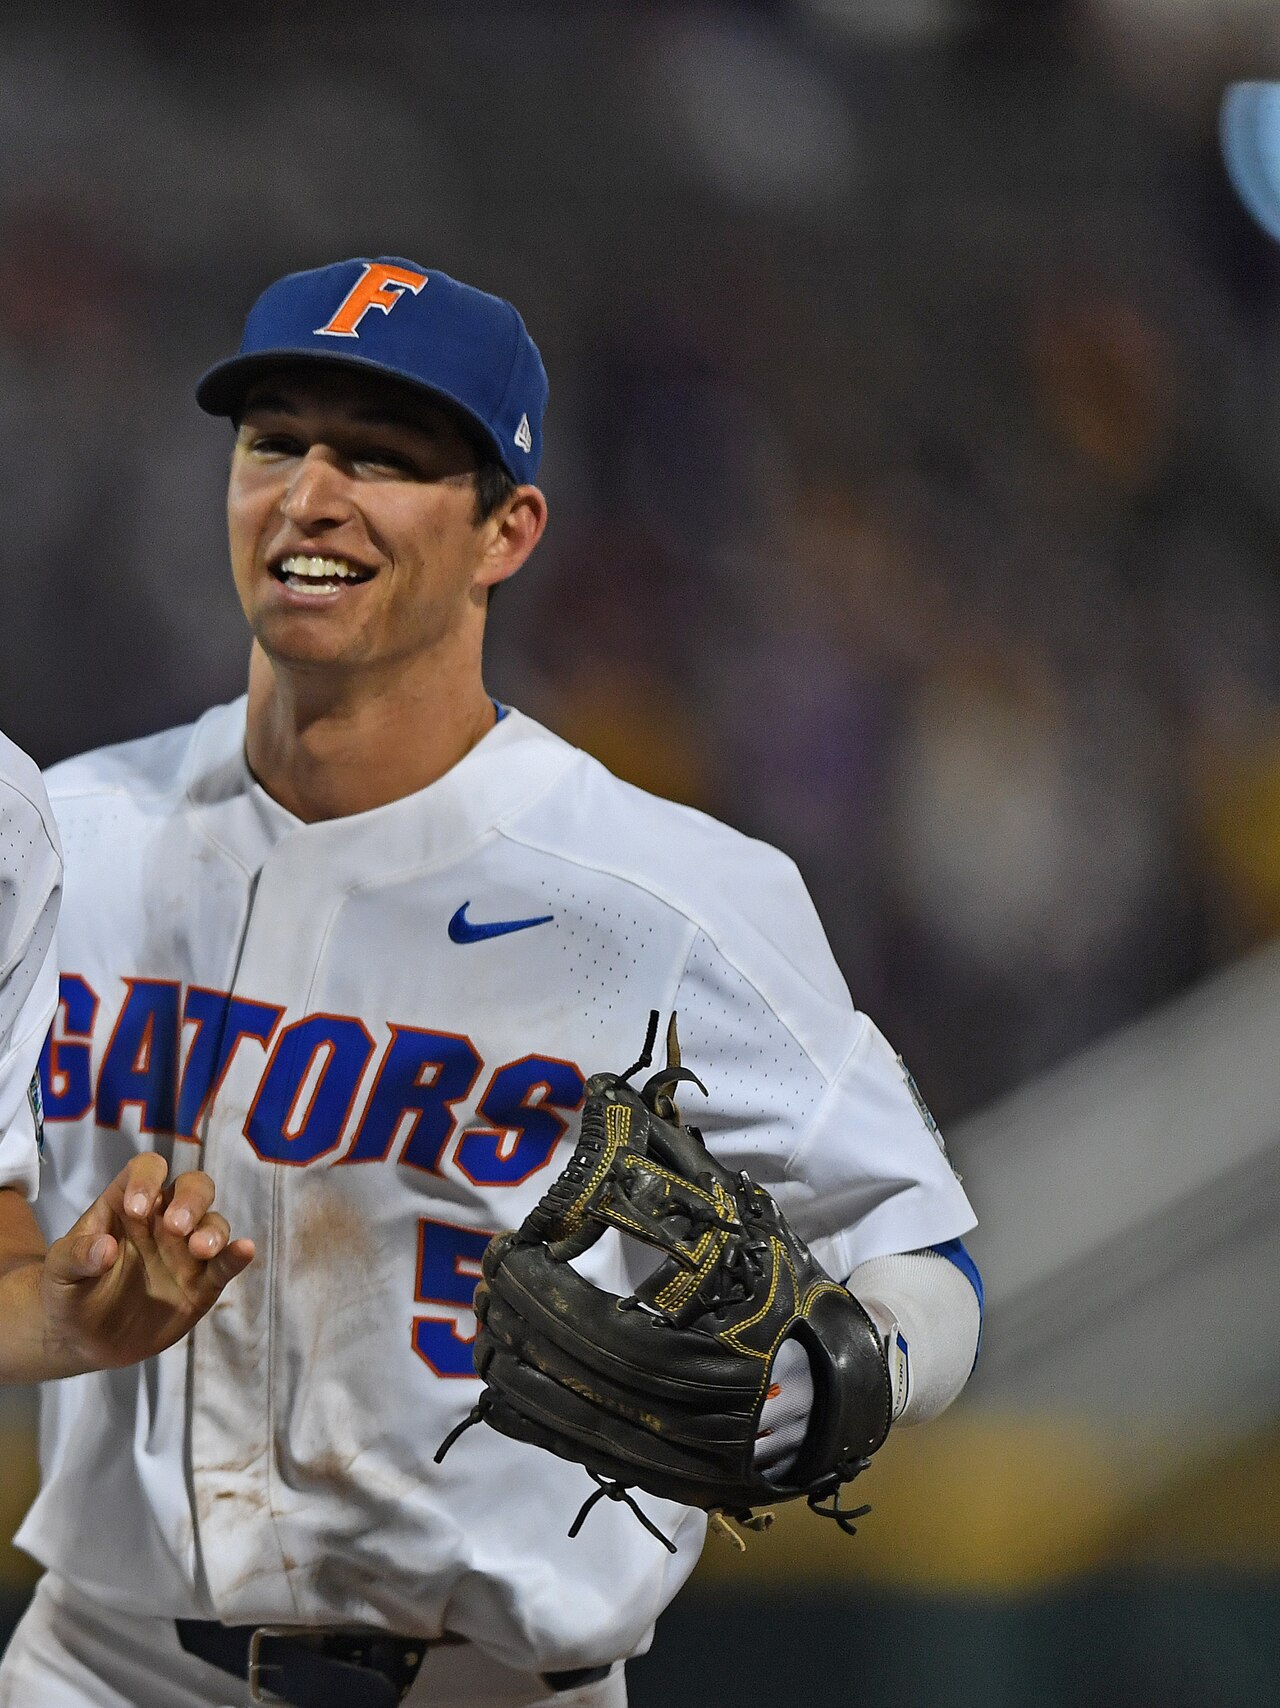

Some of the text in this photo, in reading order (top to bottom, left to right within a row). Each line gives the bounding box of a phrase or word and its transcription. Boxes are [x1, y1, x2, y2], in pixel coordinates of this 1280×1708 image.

[312, 263, 429, 338] F
[38, 972, 587, 1187] GATORS
[412, 1217, 496, 1379] 5
